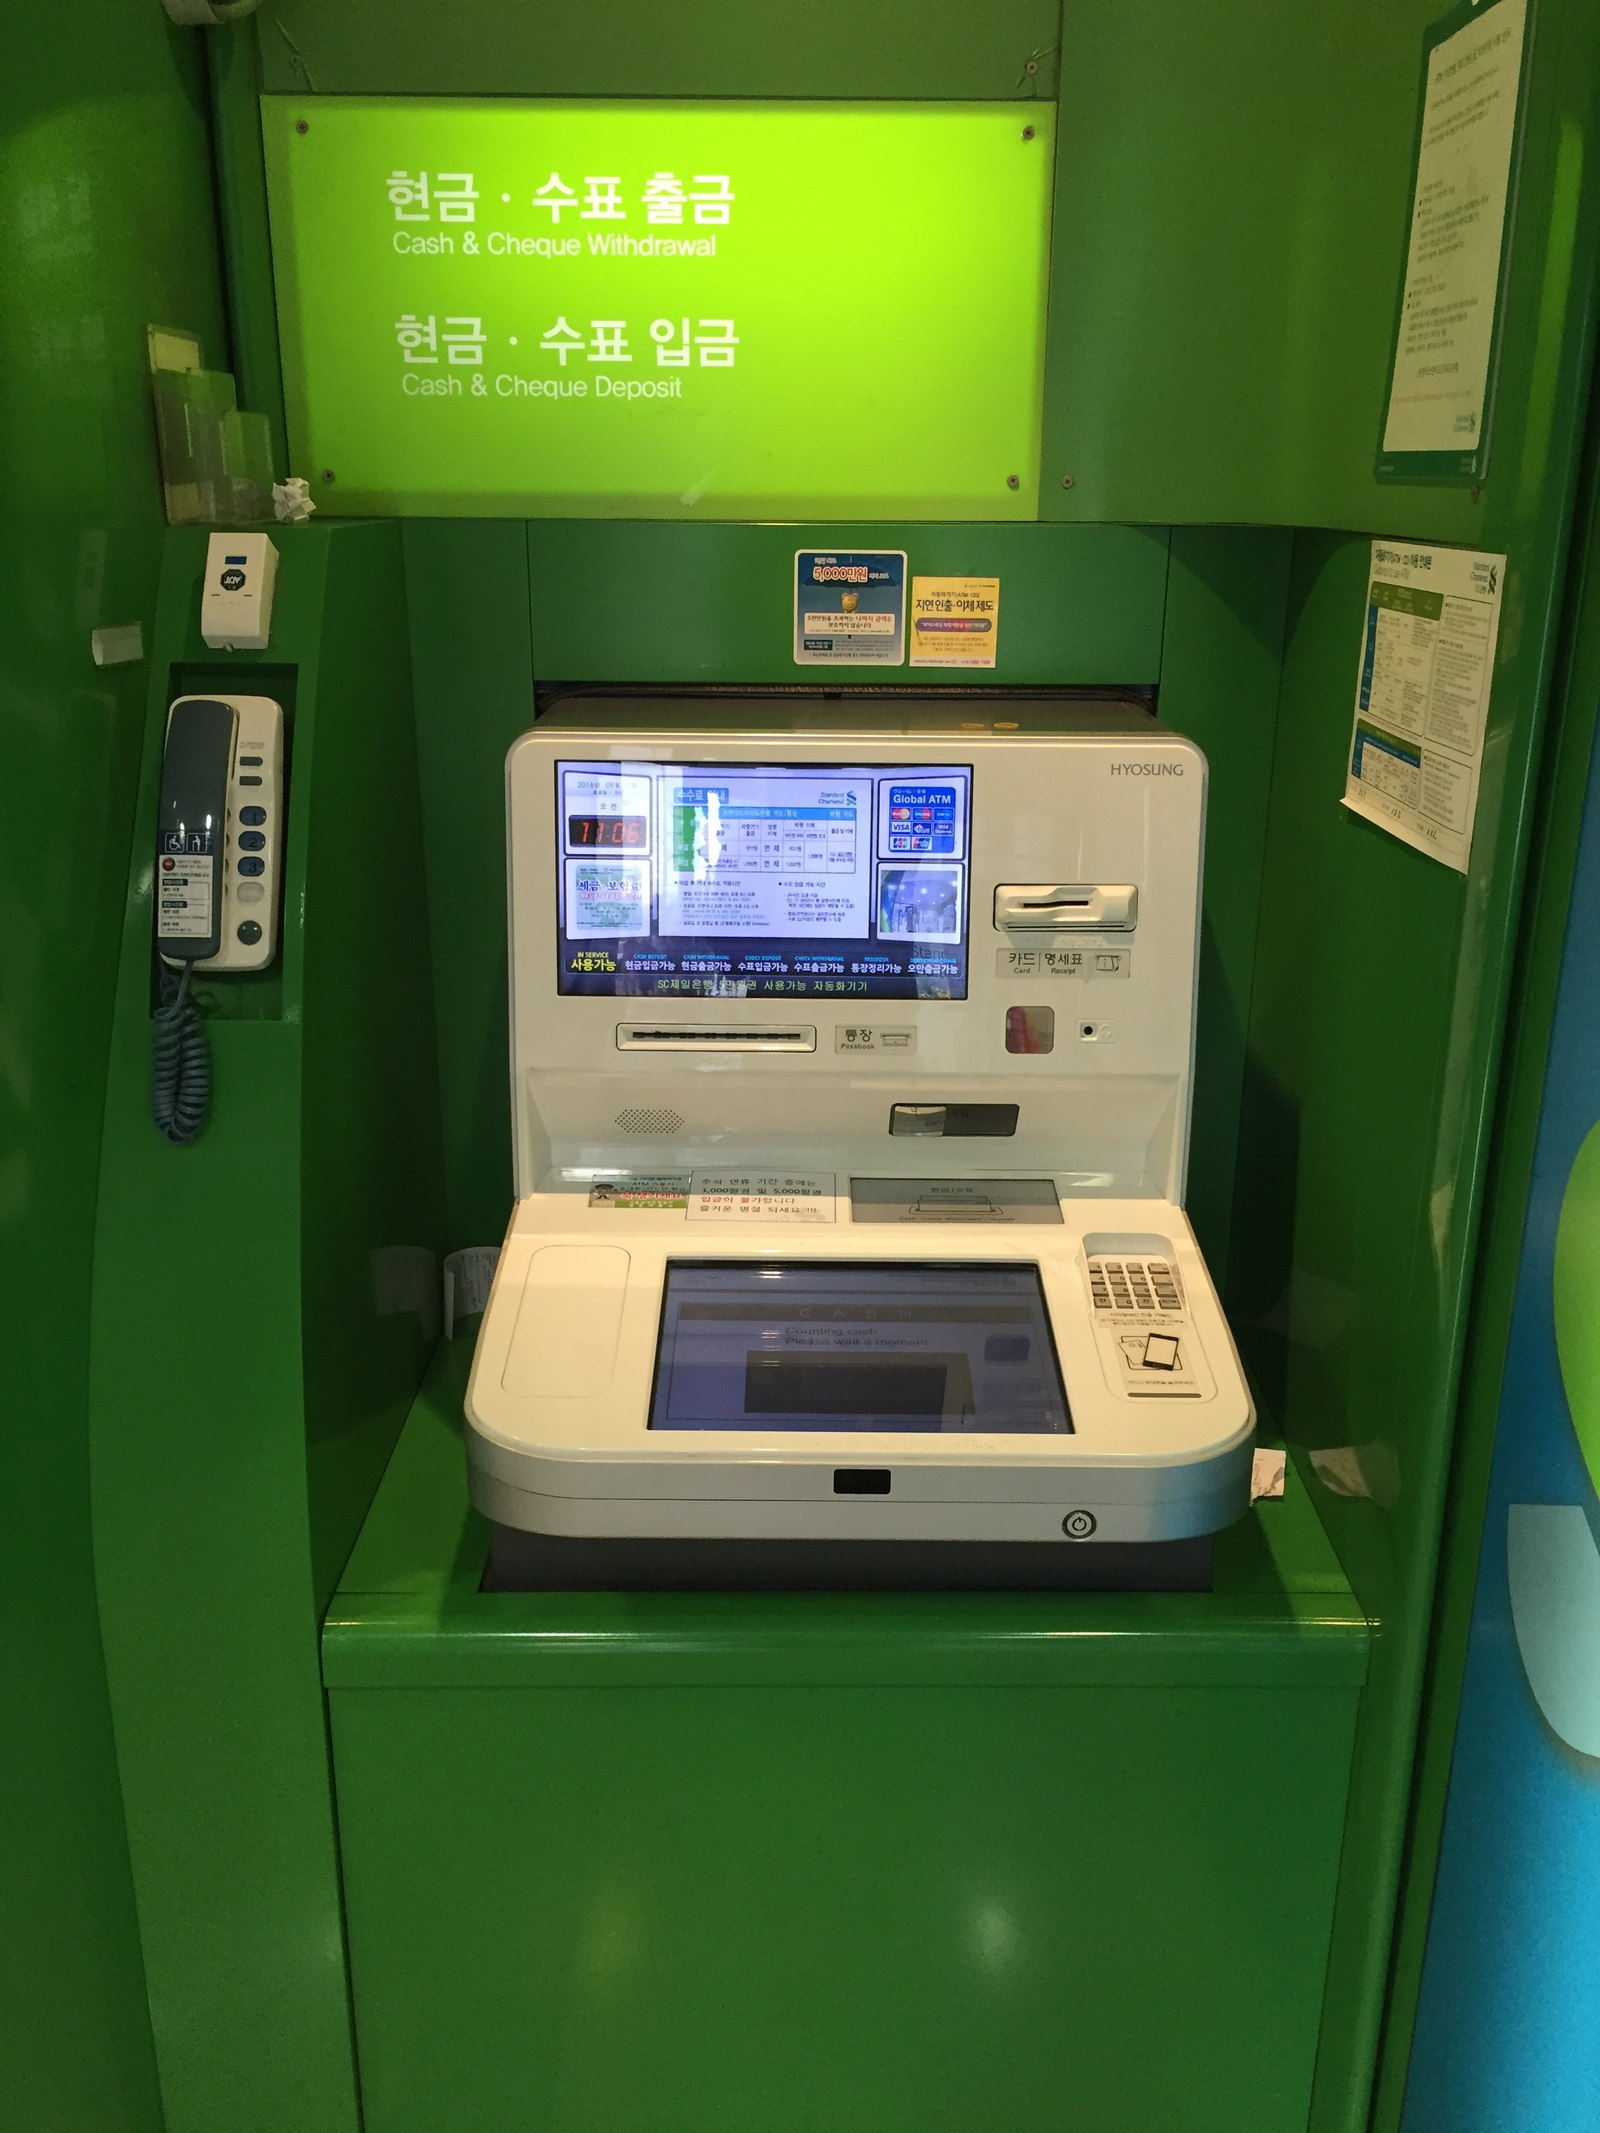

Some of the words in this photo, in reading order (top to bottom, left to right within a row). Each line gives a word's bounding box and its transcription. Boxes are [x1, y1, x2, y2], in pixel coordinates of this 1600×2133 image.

[386, 171, 479, 222] 현금
[532, 172, 626, 223] 수표
[641, 172, 735, 224] 출금
[393, 231, 454, 254] Cash
[462, 231, 480, 254] &
[487, 232, 581, 258] Cheque
[587, 233, 716, 256] Withdrawal
[395, 315, 487, 364] 현금
[540, 316, 633, 366] 수표
[650, 318, 740, 366] 입금
[402, 373, 462, 396] Cash
[471, 373, 488, 396] &
[495, 374, 587, 400] Cheque
[596, 376, 682, 400] Deposit
[813, 566, 868, 582] 5,000만원
[224, 576, 242, 584] ADT
[916, 599, 934, 611] 지연
[976, 599, 994, 612] 제도
[1111, 764, 1184, 776] HYOSUNG
[677, 790, 703, 801] 수수료
[893, 794, 926, 804] Global
[928, 795, 951, 804] ATM
[249, 837, 257, 848] 2
[248, 863, 257, 874] 3
[571, 959, 616, 971] 사용가능
[1008, 953, 1035, 965] 카드
[1045, 953, 1083, 966] 명세표
[625, 961, 676, 971] 현금입금가능
[681, 962, 732, 972] 현금출금가능
[738, 962, 788, 972] 수표입금가능
[794, 963, 845, 973] 수표출금가능
[851, 963, 902, 974] 통장정리가능
[907, 963, 958, 974] 오만출금가능
[657, 979, 713, 990] SC제일은행
[764, 980, 806, 991] 사용가능
[813, 980, 867, 991] 자동화기기
[845, 1029, 873, 1042] 통장
[841, 1042, 875, 1050] Passbook
[757, 1178, 777, 1186] 기간
[773, 1188, 822, 1196] 5,000원권
[701, 1196, 733, 1204] 입금이
[741, 1196, 795, 1204] 불가합니다
[740, 1205, 760, 1213] 명절
[799, 1307, 911, 1318] CASH
[785, 1326, 843, 1336] Counting
[847, 1327, 878, 1335] cash
[785, 1336, 830, 1345] Please
[834, 1337, 861, 1345] wait
[876, 1338, 928, 1346] moment
